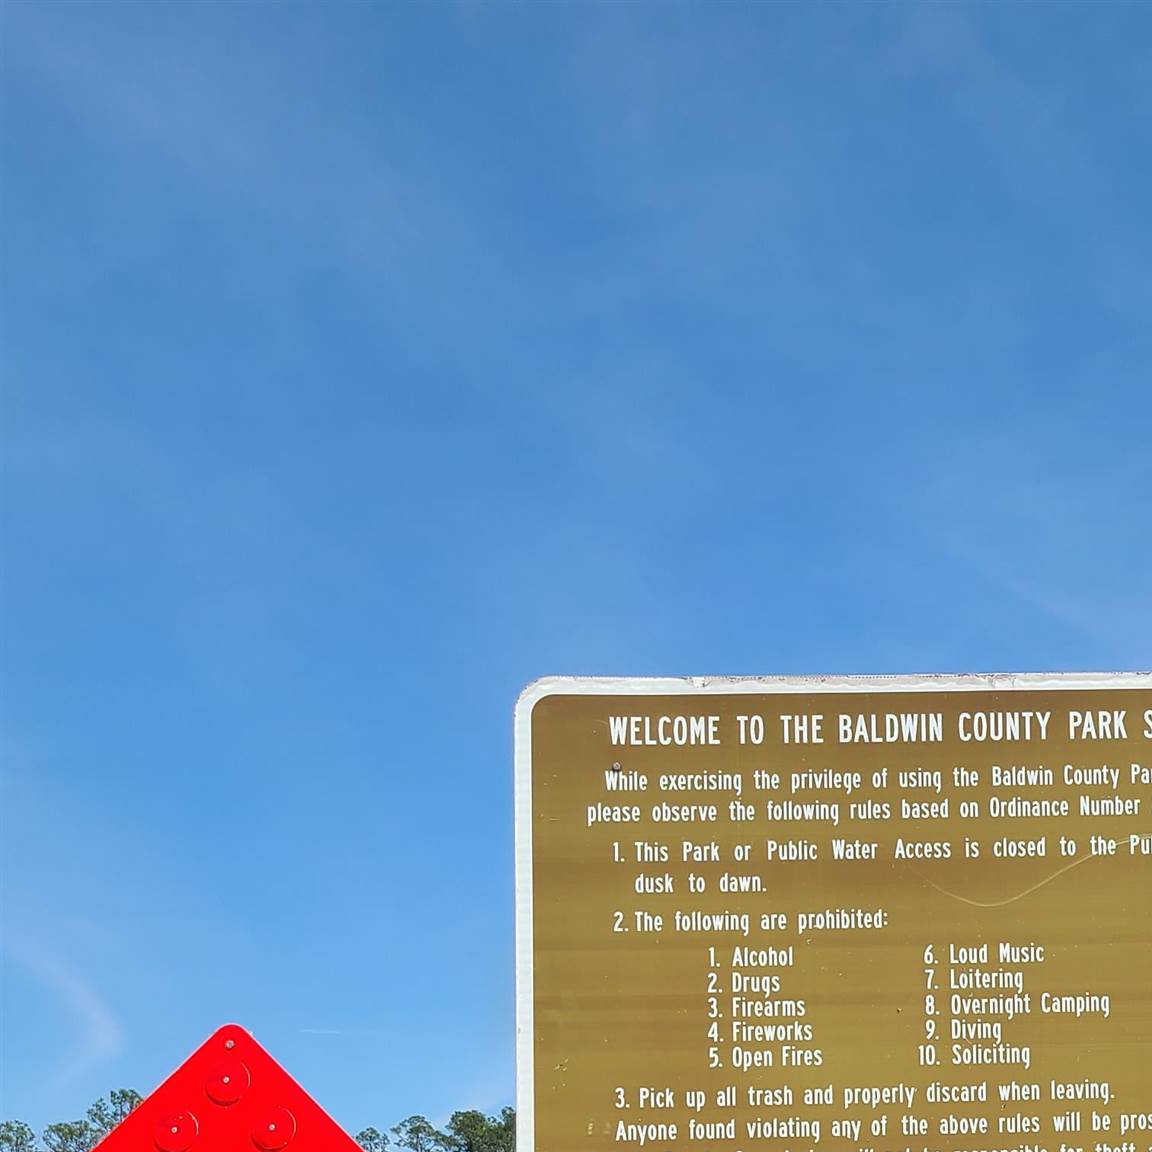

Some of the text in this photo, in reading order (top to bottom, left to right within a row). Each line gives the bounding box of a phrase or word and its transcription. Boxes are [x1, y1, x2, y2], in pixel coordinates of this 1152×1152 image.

[608, 715, 721, 746] WELCOME
[736, 714, 764, 745] TO
[779, 714, 824, 744] THE
[838, 713, 943, 743] BALDWIN
[958, 711, 1051, 742] COUNTY
[1069, 710, 1128, 740] PARK
[604, 770, 648, 791] While
[659, 770, 742, 797] exercising
[753, 769, 780, 790] the
[791, 768, 862, 795] privilege
[872, 767, 888, 789] of
[898, 771, 942, 794] using
[952, 767, 979, 787] the
[992, 765, 1053, 787] Baldwin
[1063, 764, 1120, 790] County
[587, 802, 641, 827] please
[651, 801, 717, 822] observe
[728, 800, 755, 821] the
[766, 799, 839, 826] following
[850, 799, 891, 820] rules
[901, 798, 949, 819] based
[959, 801, 979, 818] on
[989, 796, 1069, 818] Ordinance
[1079, 795, 1141, 816] Number
[613, 841, 625, 862] 1.
[634, 841, 669, 862] This
[682, 841, 720, 862] Park
[734, 844, 752, 861] or
[767, 839, 818, 861] Public
[831, 839, 878, 860] Water
[894, 838, 952, 859] Access
[965, 837, 980, 858] is
[993, 836, 1046, 857] closed
[1059, 836, 1077, 857] to
[1089, 835, 1117, 856] the
[634, 872, 767, 894] dusk to dawn.
[613, 908, 888, 937] 2. The following are prohibited:
[708, 946, 793, 967] 1. Alcohol
[923, 942, 1045, 965] 6. Loud Music
[707, 971, 781, 999] 2. Drugs
[923, 967, 1024, 994] 7. Loitering
[708, 996, 806, 1018] 3. Firearms
[925, 991, 1110, 1020] 8. Overnight Camping
[707, 1020, 813, 1042] 4. Fireworks
[925, 1017, 1002, 1045] 9. Diving
[709, 1045, 823, 1072] 5. Open Fires
[918, 1044, 1031, 1070] 10. Soliciting
[615, 1078, 1115, 1112] 3. Pick up all trash and properly discard when leaving.
[615, 1120, 678, 1146] Anyone
[689, 1118, 736, 1140] found
[746, 1116, 820, 1144] violating
[831, 1120, 861, 1142] any
[871, 1115, 887, 1136] of
[901, 1115, 928, 1136] the
[939, 1114, 988, 1135] above
[998, 1113, 1040, 1134] rules
[1052, 1111, 1081, 1132] will
[1091, 1111, 1111, 1131] be
